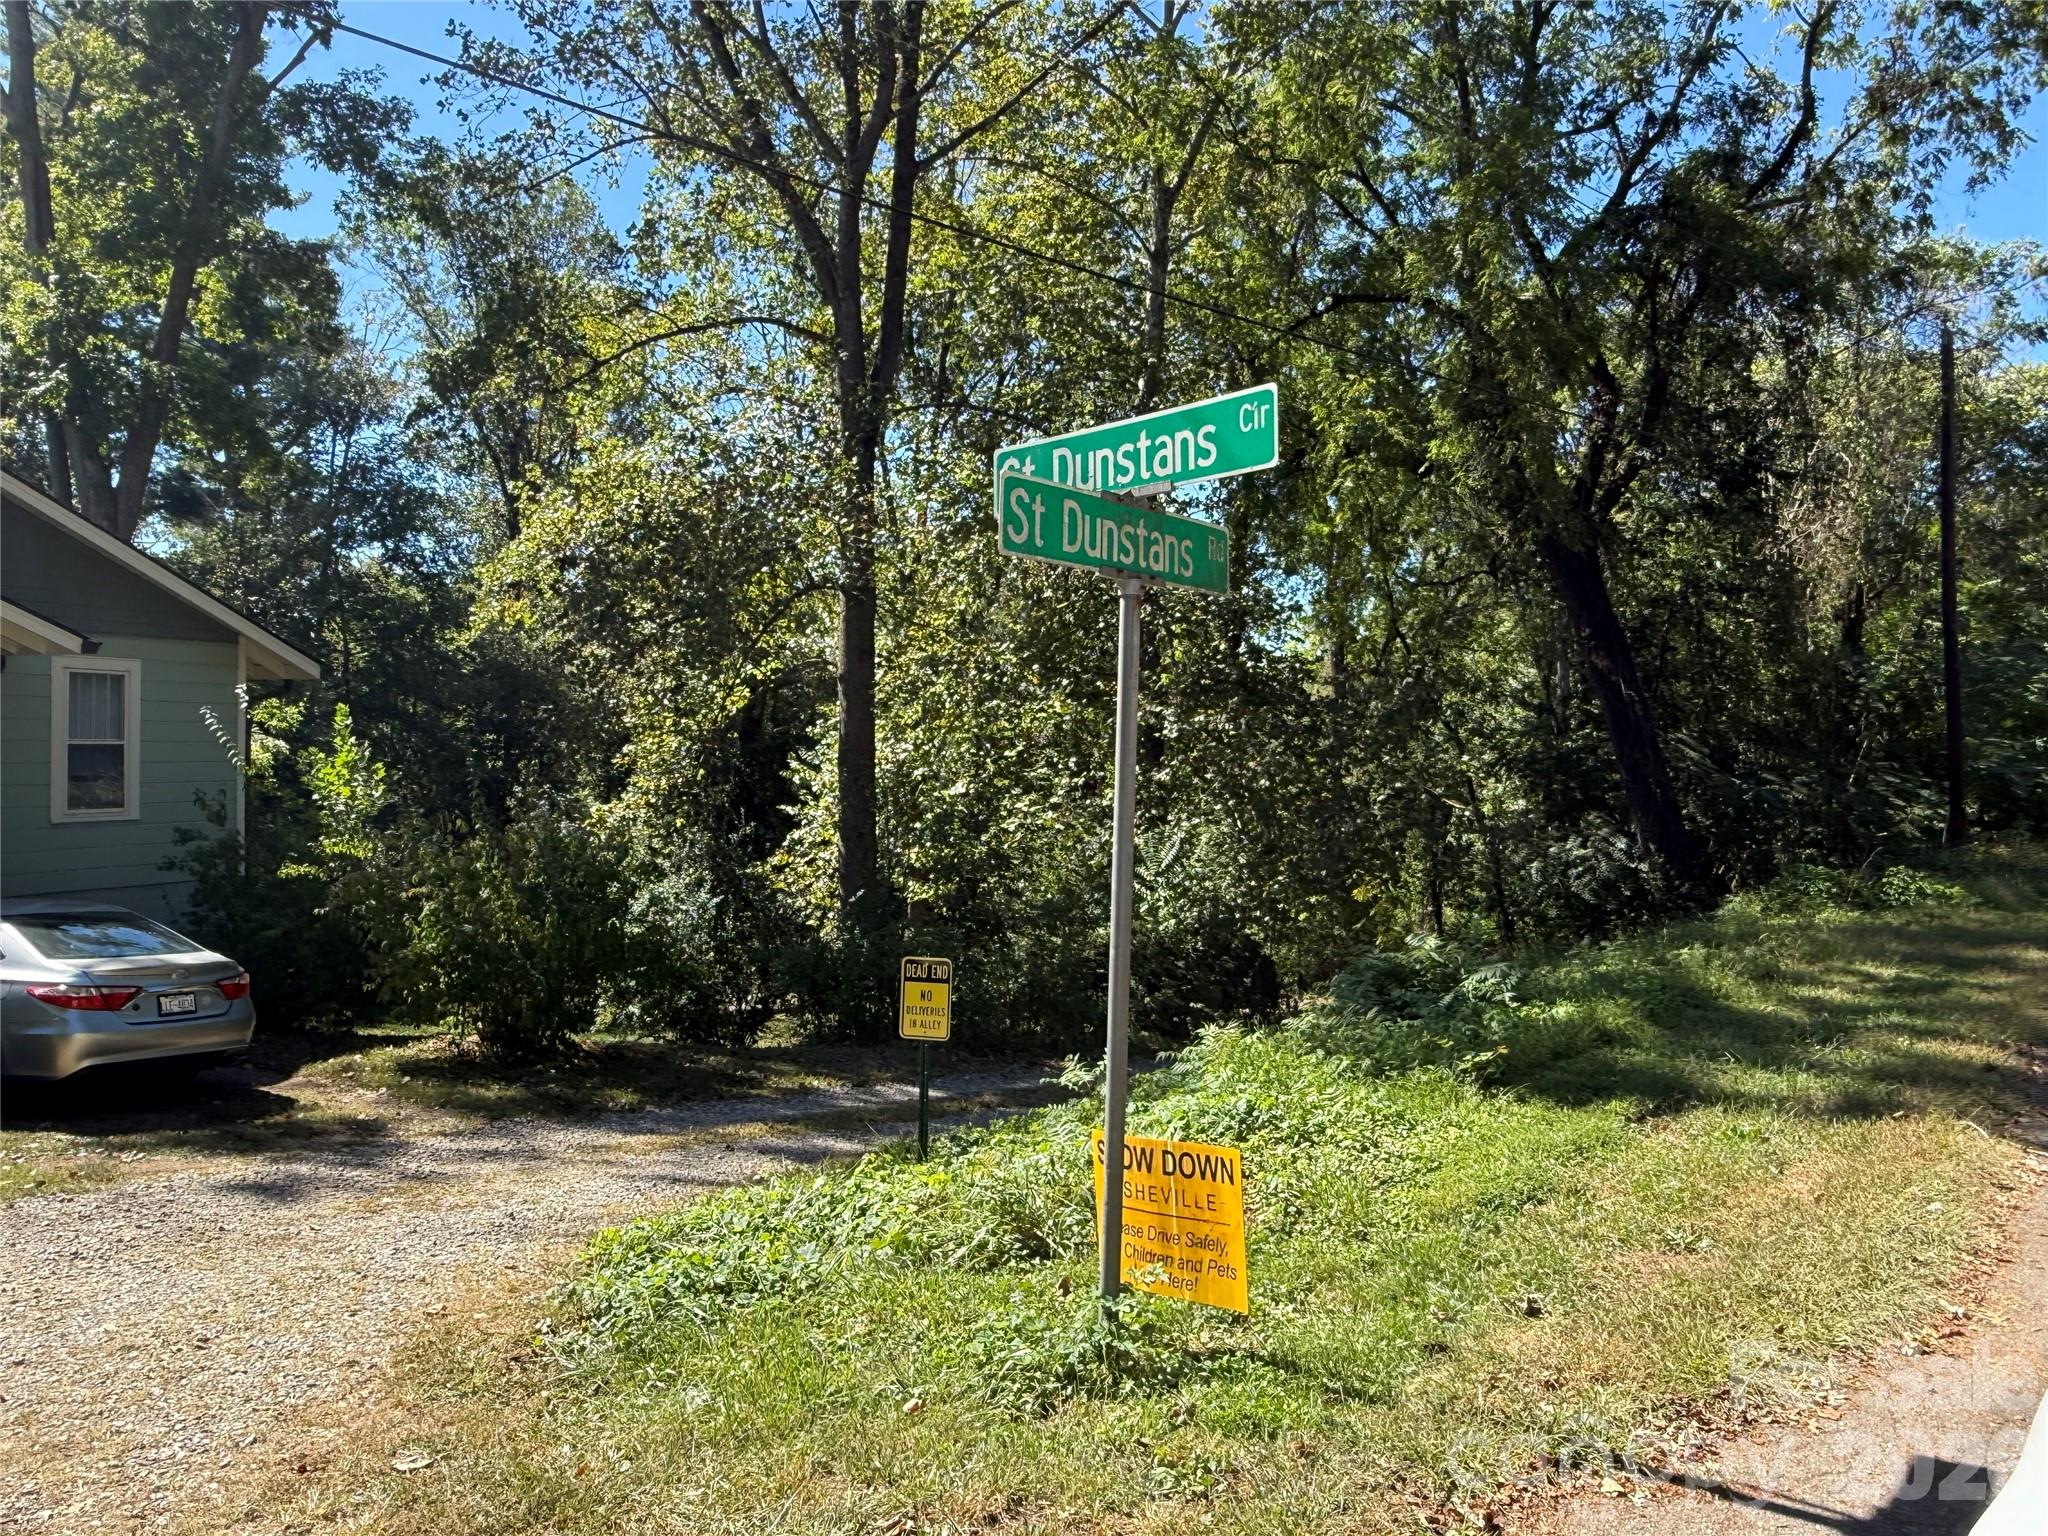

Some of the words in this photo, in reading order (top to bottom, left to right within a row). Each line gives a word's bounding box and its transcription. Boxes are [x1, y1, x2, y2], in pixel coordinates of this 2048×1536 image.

[1053, 424, 1217, 491] Dunstans
[1239, 401, 1270, 433] Cir
[1007, 488, 1045, 548] St
[1062, 499, 1193, 577] Dunstans
[906, 963, 929, 978] DEAD
[931, 965, 948, 979] END
[906, 1005, 946, 1016] DELIVERIES
[920, 990, 932, 1002] NO
[909, 1019, 917, 1028] IN
[920, 1020, 941, 1030] ALLEY
[1097, 1139, 1154, 1174] SOW
[1161, 1150, 1235, 1186] DOWN
[1123, 1181, 1217, 1211] SHEVILLE
[1148, 1225, 1181, 1246] Drive
[1185, 1231, 1228, 1257] Safely,
[1125, 1242, 1174, 1268] Children
[1178, 1257, 1203, 1273] and
[1207, 1259, 1237, 1281] Pets
